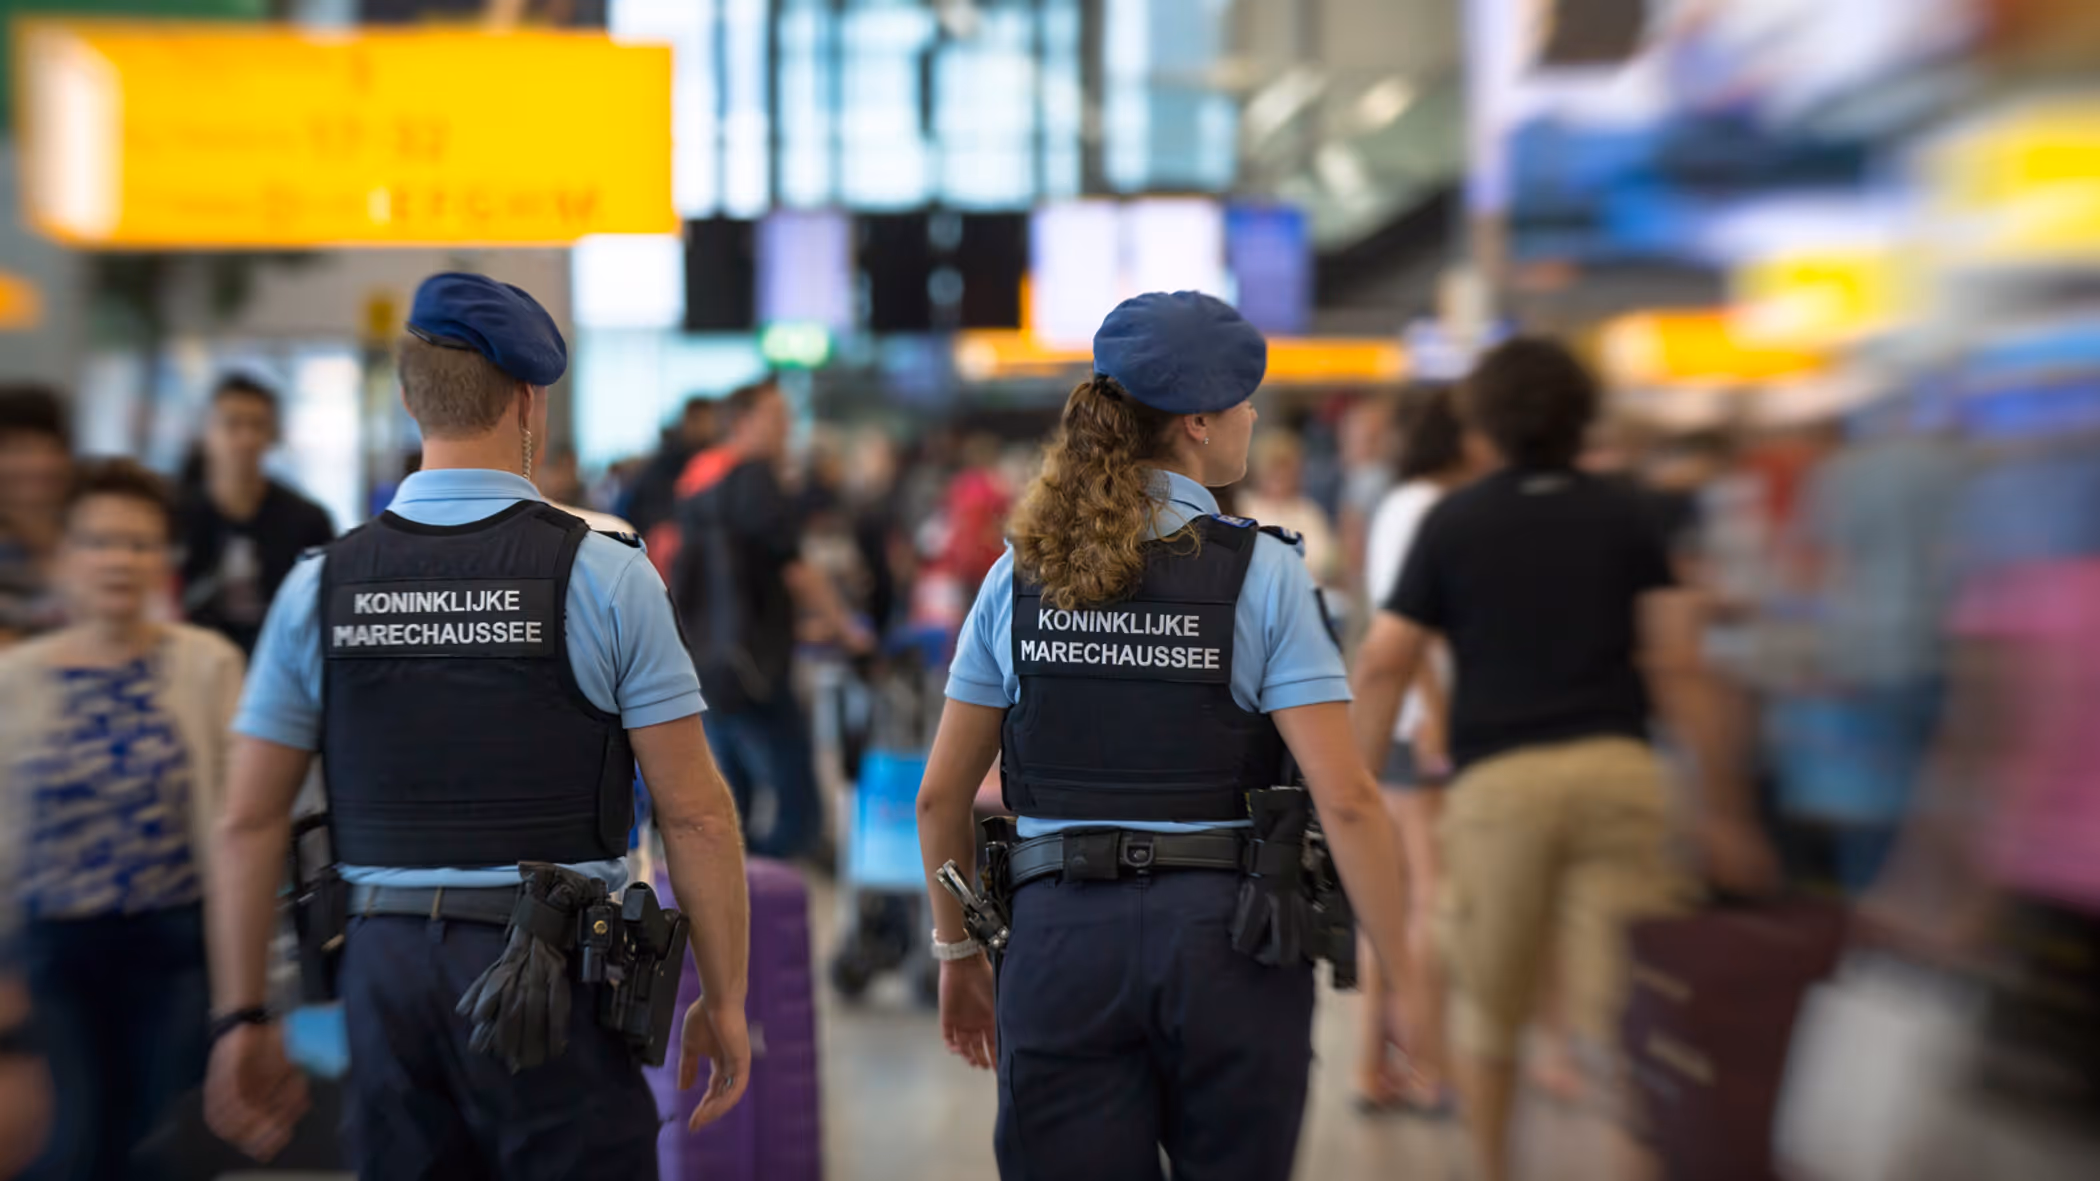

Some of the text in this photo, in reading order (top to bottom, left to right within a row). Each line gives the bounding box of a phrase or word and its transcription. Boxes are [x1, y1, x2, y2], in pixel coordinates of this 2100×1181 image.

[354, 590, 520, 614] KONINKLIJKE
[333, 621, 542, 647] MARECHAUSSEE
[1038, 608, 1200, 636] KONINKLIJKE
[1020, 639, 1220, 669] MARECHAUSSEE
